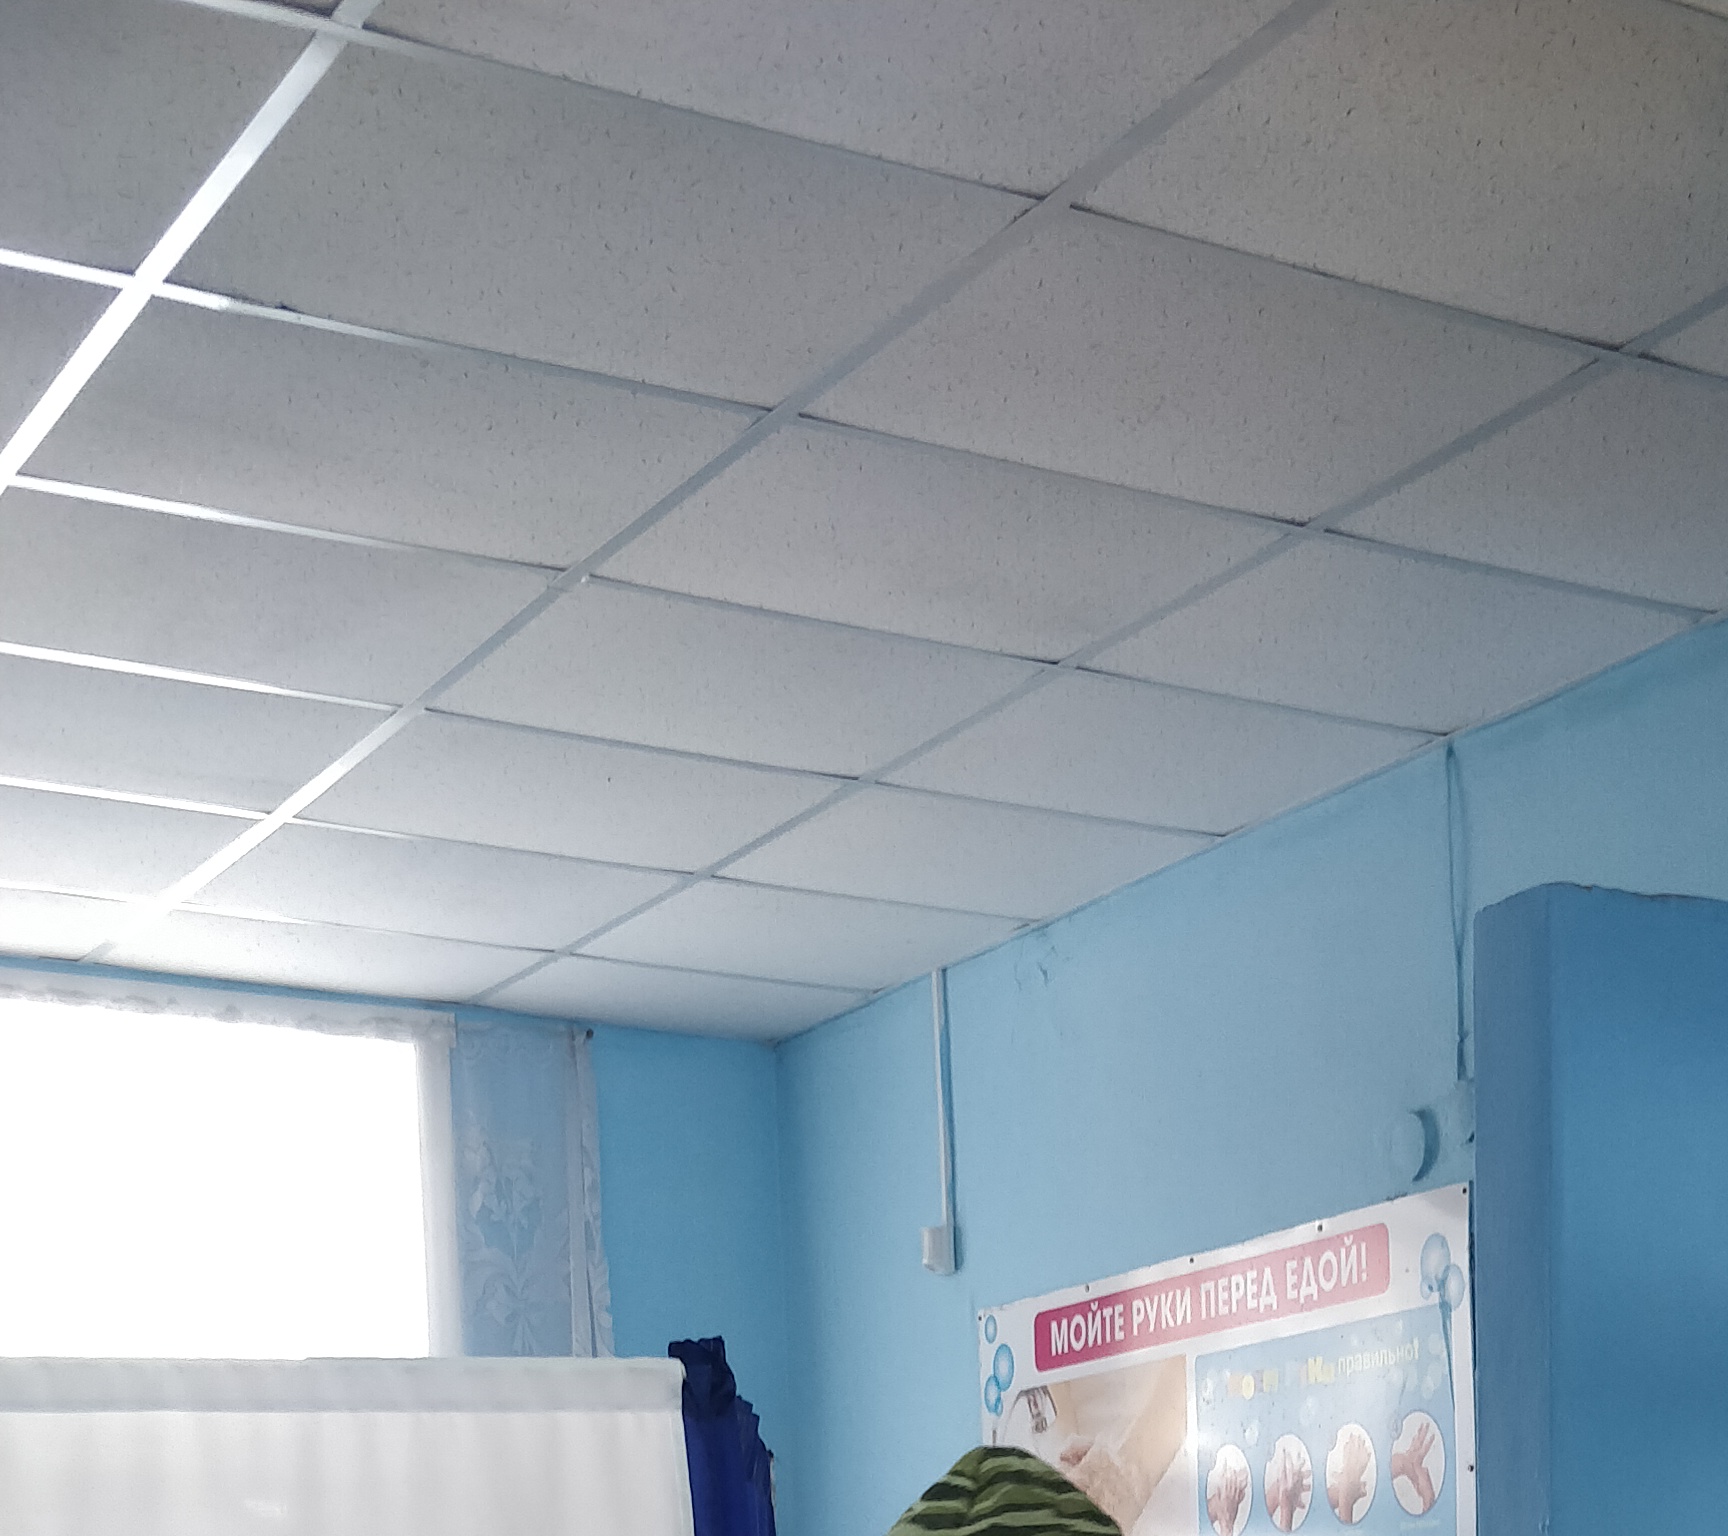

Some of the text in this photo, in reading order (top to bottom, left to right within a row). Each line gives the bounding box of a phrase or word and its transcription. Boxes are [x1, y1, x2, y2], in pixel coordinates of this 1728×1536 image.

[1051, 1235, 1369, 1357] МОЙТЕ РУКИ ПЕРЕД ЕДОЙ!
[1338, 1337, 1419, 1376] правильно!
